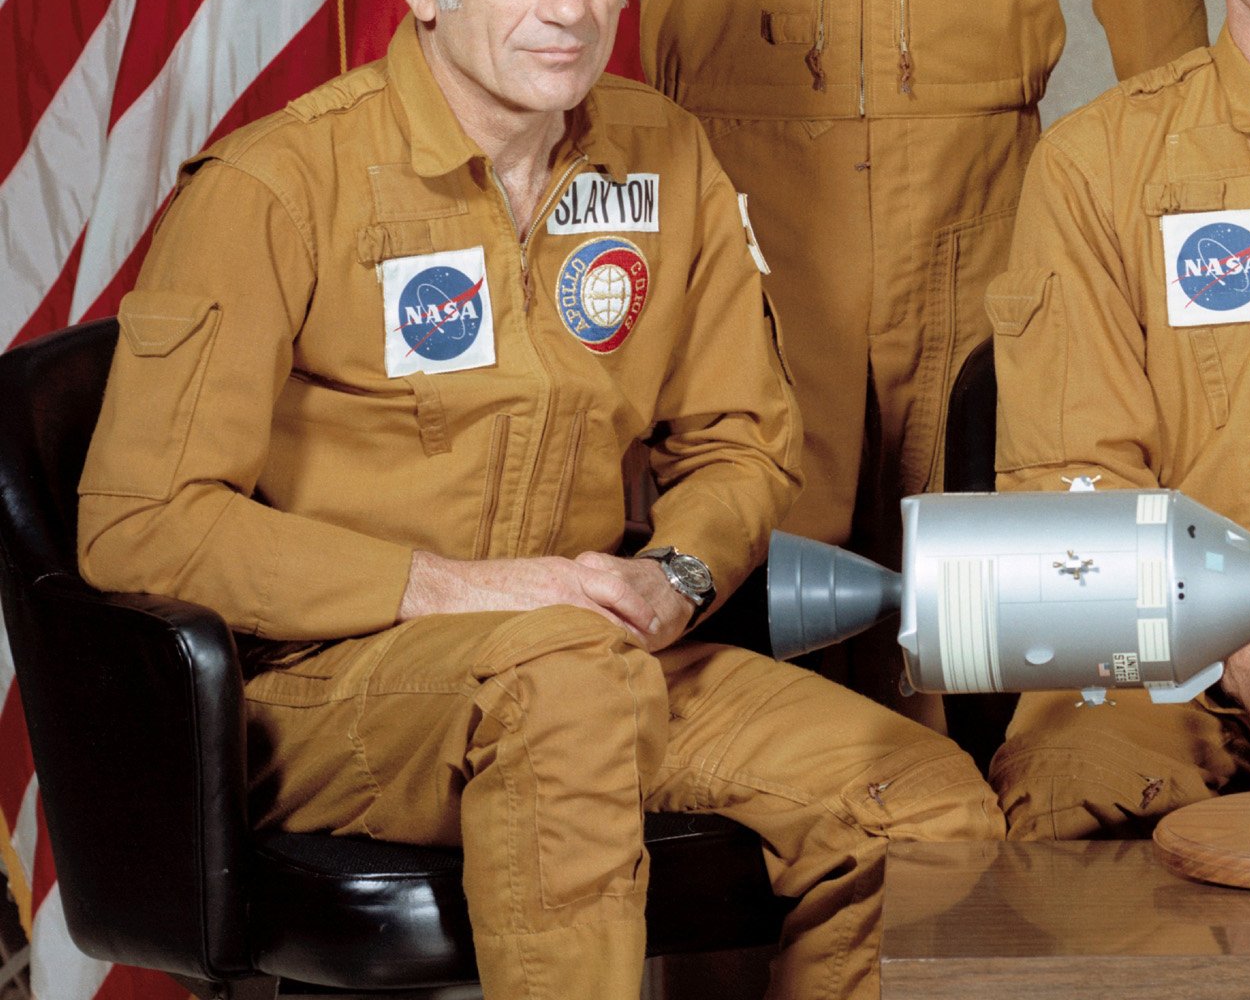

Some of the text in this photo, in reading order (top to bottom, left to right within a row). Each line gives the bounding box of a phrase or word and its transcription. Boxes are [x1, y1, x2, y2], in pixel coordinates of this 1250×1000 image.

[554, 179, 654, 226] SLAYTON
[562, 258, 591, 332] APOLLO
[404, 301, 479, 326] NASA
[1114, 655, 1127, 681] STATES
[1127, 655, 1138, 680] UNITED
